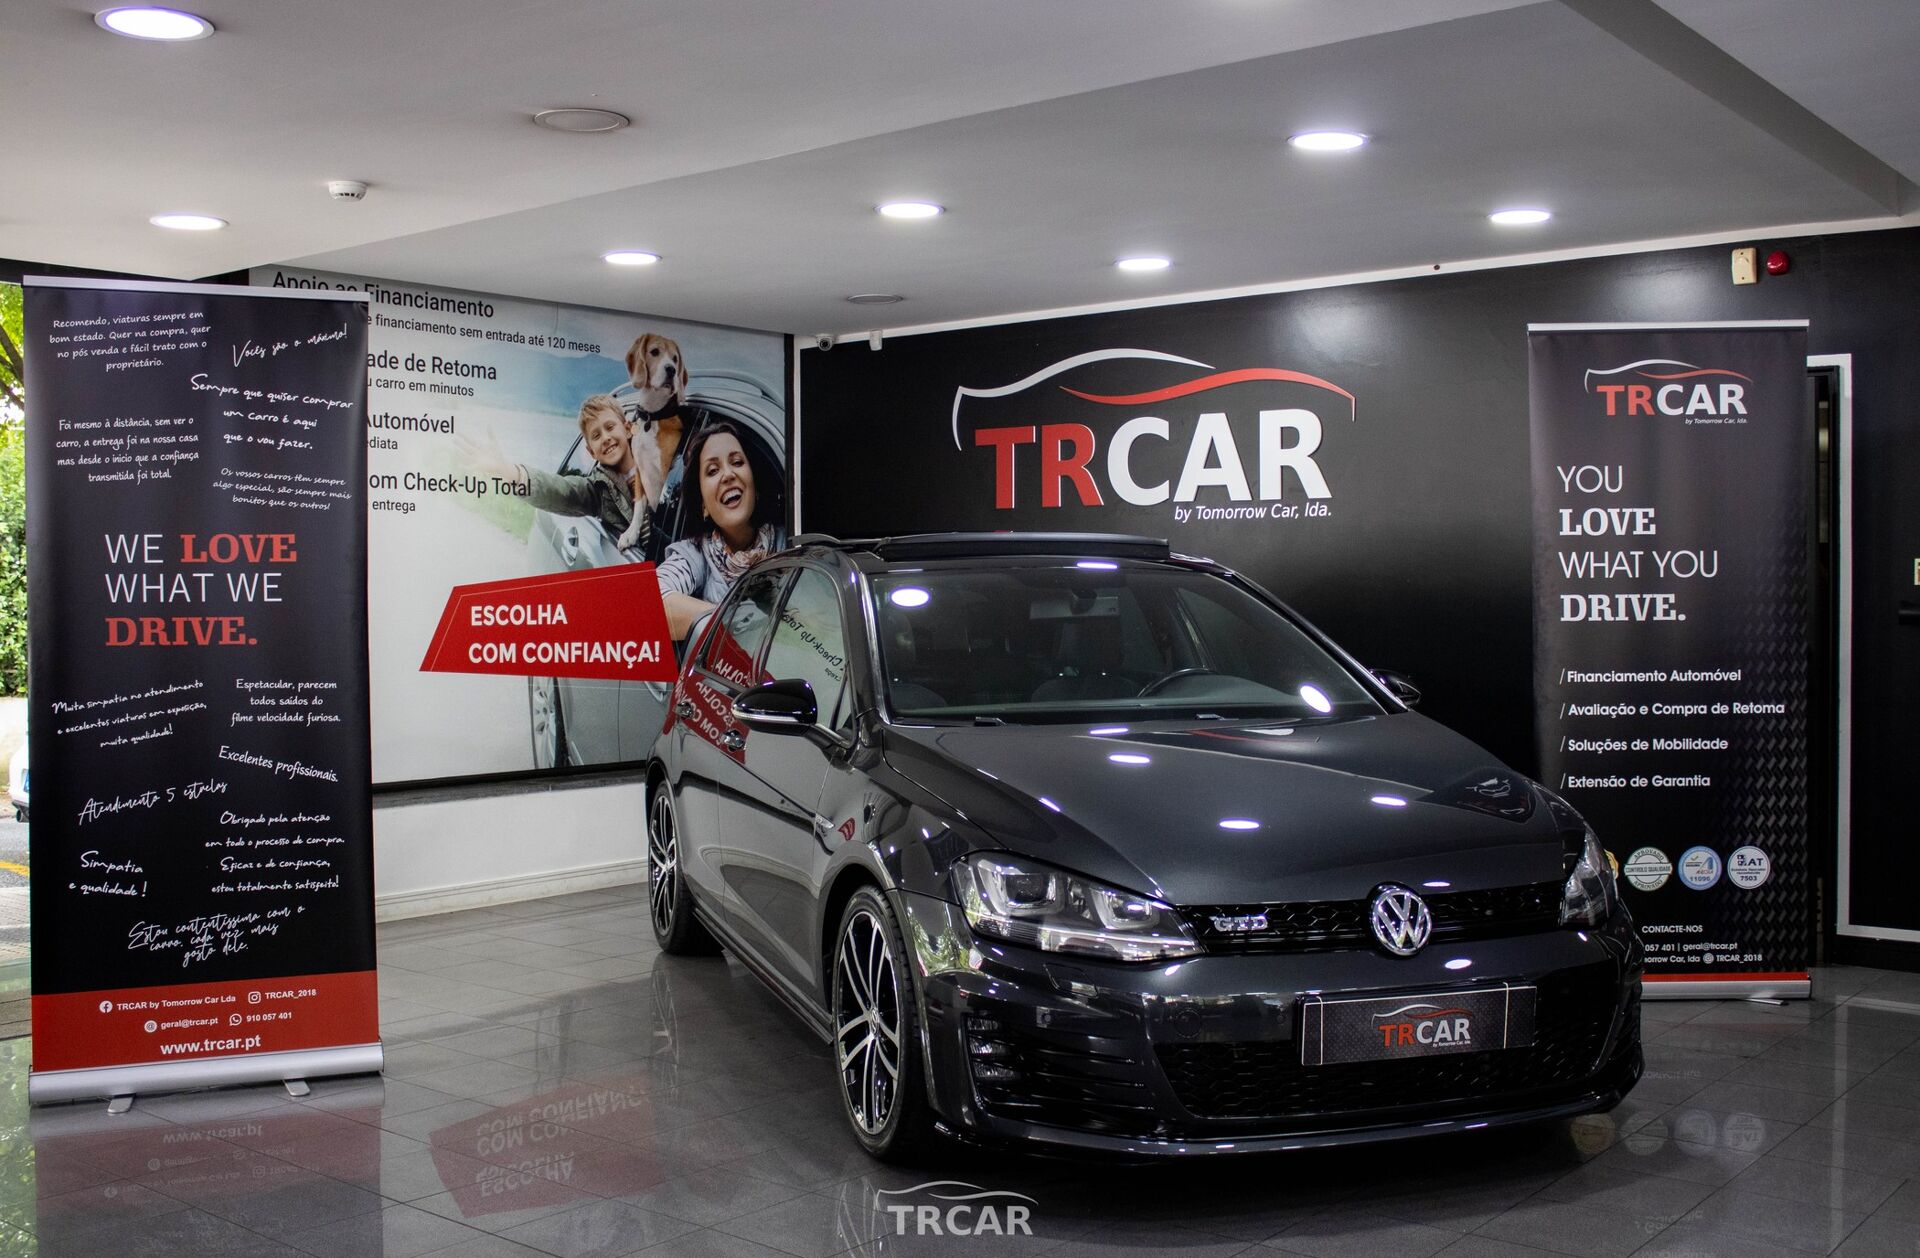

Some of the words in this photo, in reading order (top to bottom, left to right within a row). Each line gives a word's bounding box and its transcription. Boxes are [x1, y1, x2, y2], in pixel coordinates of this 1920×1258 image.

[364, 284, 494, 318] Financiamento
[53, 317, 110, 328] Recomendo,
[113, 315, 150, 325] viaturas
[153, 312, 186, 323] sempre
[190, 312, 204, 320] em
[50, 334, 70, 343] bom
[74, 332, 106, 342] estado.
[109, 331, 132, 340] Quer
[150, 328, 188, 339] compra,
[191, 326, 212, 336] quer
[376, 314, 457, 336] financiamento
[460, 328, 483, 339] sem
[486, 328, 526, 346] entrada
[529, 333, 545, 347] até
[547, 336, 566, 349] 120
[568, 341, 601, 353] meses
[73, 348, 89, 359] pós
[91, 346, 119, 356] venda
[131, 343, 150, 353] fácil
[152, 342, 177, 351] trato
[106, 358, 164, 372] proprietário.
[405, 353, 426, 373] de
[432, 356, 497, 380] Retoma
[191, 374, 240, 396] Sempre
[244, 390, 263, 400] que
[267, 392, 299, 403] quiser
[302, 396, 354, 410] comprar
[376, 378, 406, 390] carro
[409, 382, 426, 392] em
[430, 382, 474, 397] minutos
[1597, 384, 1748, 416] TRCAR
[248, 413, 279, 423] carro
[282, 415, 290, 424] é
[293, 419, 317, 430] aqui
[1685, 418, 1693, 426] by
[223, 434, 244, 444] que
[277, 439, 313, 450] fazer.
[368, 436, 398, 449] diata
[975, 409, 1333, 509] TRCAR
[404, 472, 487, 498] Check-Up
[492, 478, 532, 497] Total
[1557, 466, 1623, 493] YOU
[372, 500, 415, 514] entrega
[1175, 507, 1192, 523] by
[1196, 506, 1267, 520] Tomorrow
[1271, 504, 1299, 520] Car,
[1559, 508, 1656, 536] LOVE
[105, 534, 164, 564] WE
[180, 534, 297, 564] LOVE
[1559, 552, 1644, 578] WHAT
[1652, 550, 1718, 578] YOU
[105, 573, 214, 604] WHAT
[226, 572, 283, 603] WE
[471, 604, 568, 627] ESCOLHA
[1560, 594, 1686, 622] DRIVE.
[105, 616, 258, 647] DRIVE.
[469, 643, 518, 663] COM
[523, 640, 660, 669] CONFIANÇA!
[1567, 670, 1667, 683] Financiamento
[1670, 669, 1741, 682] Automóvel
[236, 679, 295, 692] Espetacular,
[298, 682, 338, 693] parecem
[52, 701, 86, 715] Muita
[87, 694, 128, 708] simpatia
[144, 680, 204, 697] atendimento
[250, 696, 276, 706] todos
[280, 696, 309, 706] saídos
[312, 696, 324, 705] do
[231, 712, 254, 728] filme
[257, 713, 304, 722] velocidade
[306, 712, 341, 727] furiosa.
[1568, 703, 1636, 719] Avaliação
[1640, 706, 1649, 715] e
[1652, 703, 1708, 717] Compra
[1711, 703, 1729, 714] de
[1733, 702, 1785, 714] Retoma
[66, 718, 110, 733] excelentes
[112, 712, 147, 724] viaturas
[149, 710, 165, 718] em
[100, 736, 129, 748] muita
[131, 723, 173, 744] qualidade!
[1568, 739, 1627, 754] Soluções
[1631, 739, 1649, 751] de
[1653, 739, 1728, 751] Mobilidade
[219, 746, 273, 769] Excelentes
[275, 761, 338, 782] profissionais.
[1568, 776, 1627, 788] Extensão
[1630, 776, 1648, 787] de
[1652, 775, 1711, 787] Garantia
[78, 791, 161, 826] Atendimento
[166, 788, 176, 803] 5
[183, 778, 228, 800] estrelas
[81, 850, 143, 874] Simpatia
[69, 882, 76, 890] e
[81, 882, 138, 896] qualidade
[1642, 925, 1703, 934] CONTACTE-NOS
[1644, 944, 1659, 952] 057
[1683, 943, 1738, 952] geral@trcar.pt
[1716, 954, 1762, 964] TRCAR_2018
[117, 1002, 148, 1011] TRCAR
[149, 1001, 160, 1010] by
[162, 998, 203, 1008] Tomorrow
[205, 996, 219, 1004] Car
[221, 995, 236, 1003] Lda
[265, 989, 317, 1000] TRCAR_2018
[161, 1017, 218, 1030] geral@trcar.pt
[246, 1014, 261, 1022] 910
[262, 1013, 277, 1021] 057
[278, 1012, 292, 1020] 401
[1378, 1019, 1471, 1049] TRCAR
[160, 1034, 261, 1055] www.trcar.pt
